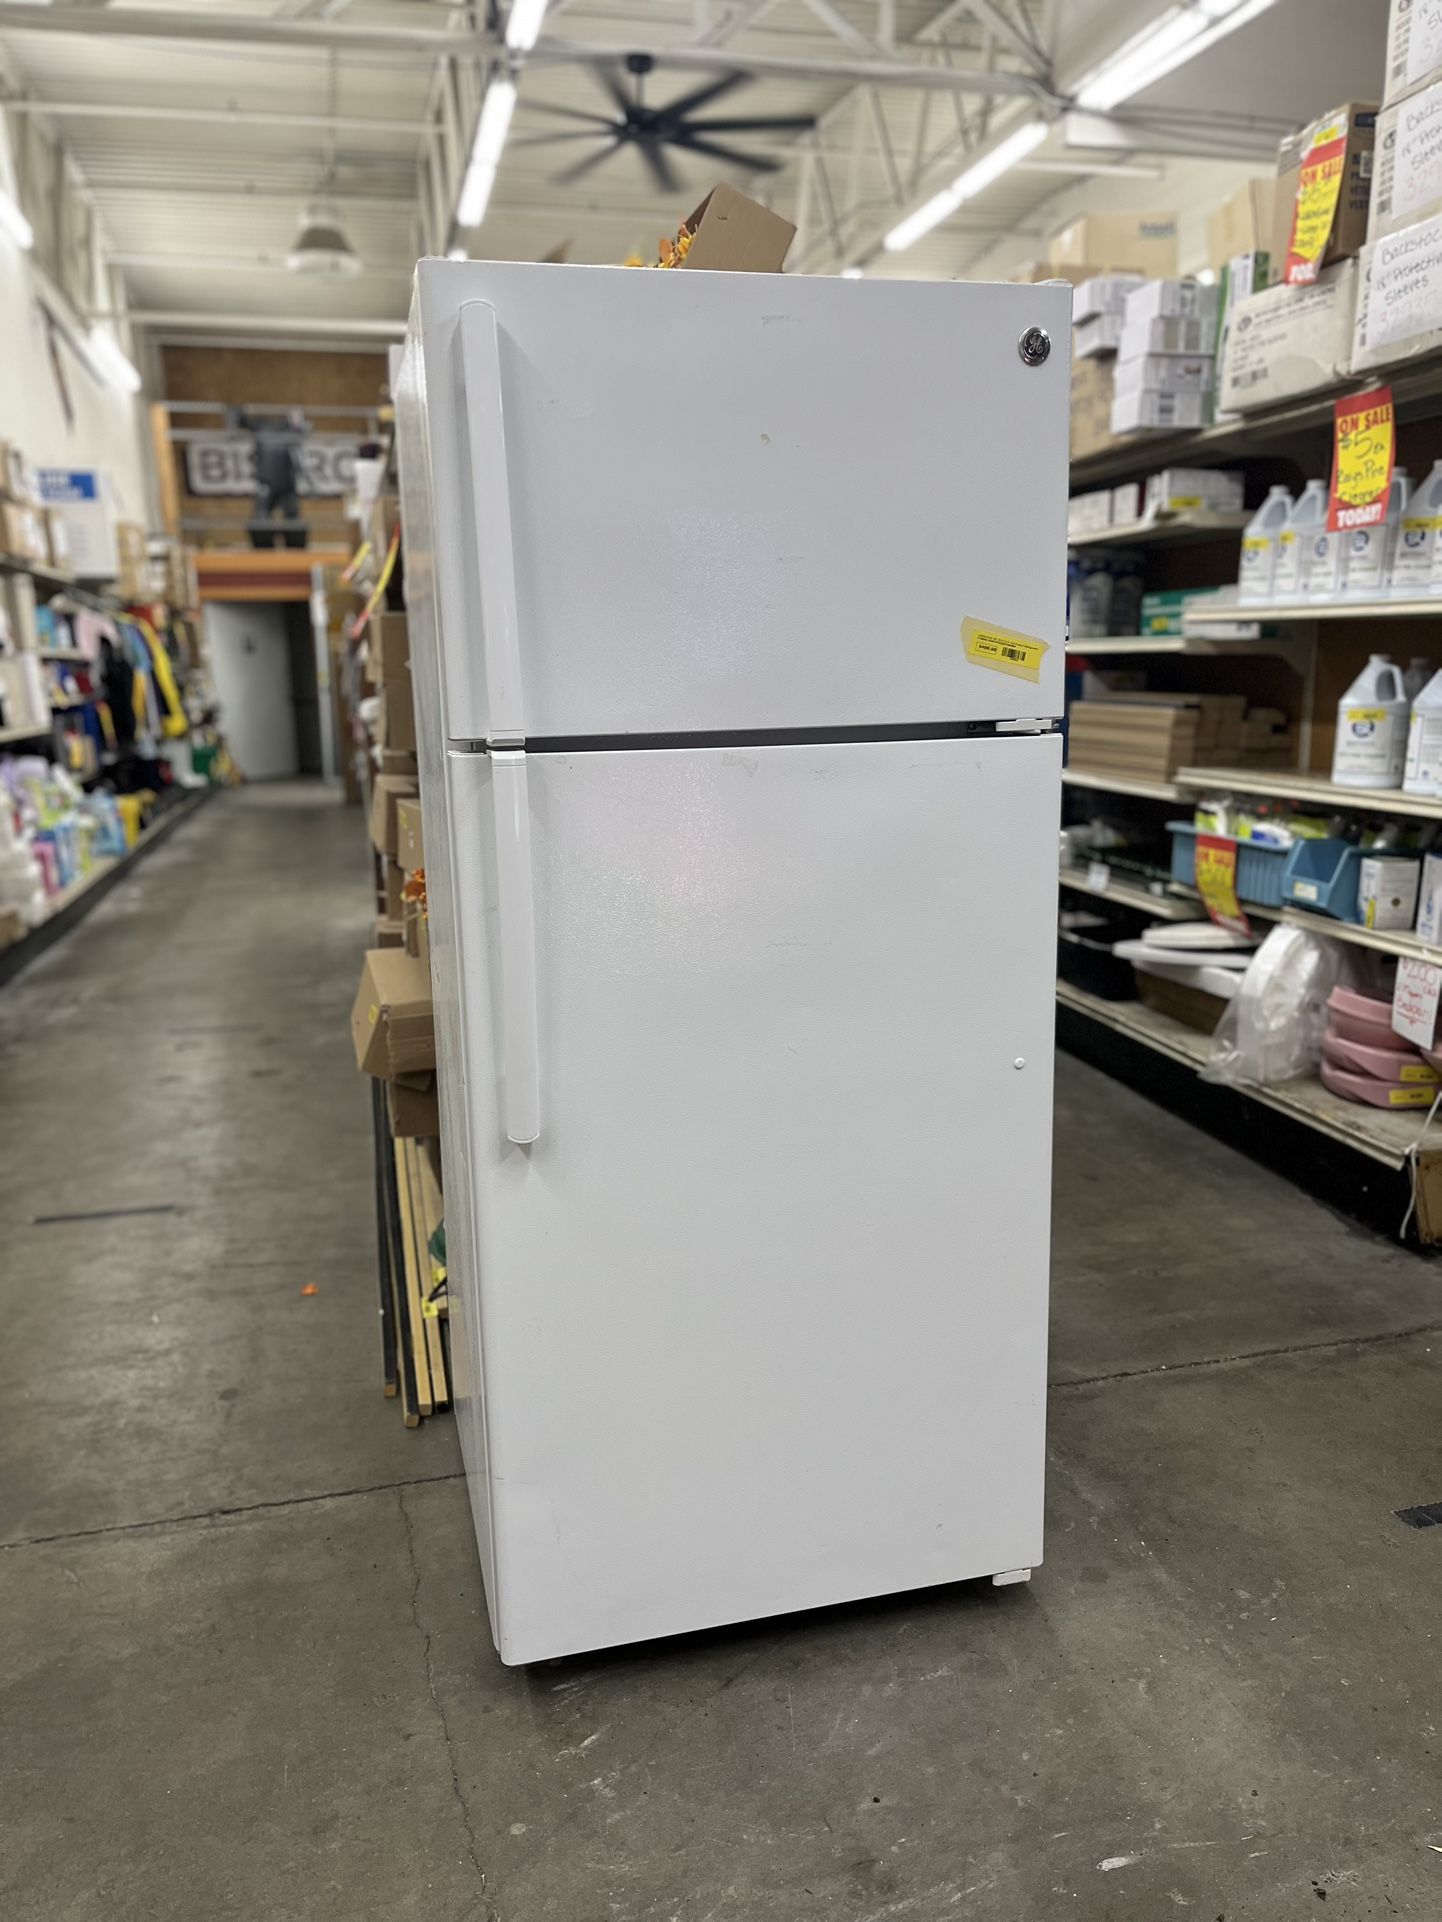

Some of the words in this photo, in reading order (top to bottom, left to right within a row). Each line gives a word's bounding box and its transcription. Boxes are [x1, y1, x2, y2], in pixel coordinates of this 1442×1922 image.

[1385, 274, 1430, 307] Sleeves
[1339, 415, 1360, 433] ON
[1364, 404, 1391, 430] SALE
[1338, 426, 1374, 460] $5
